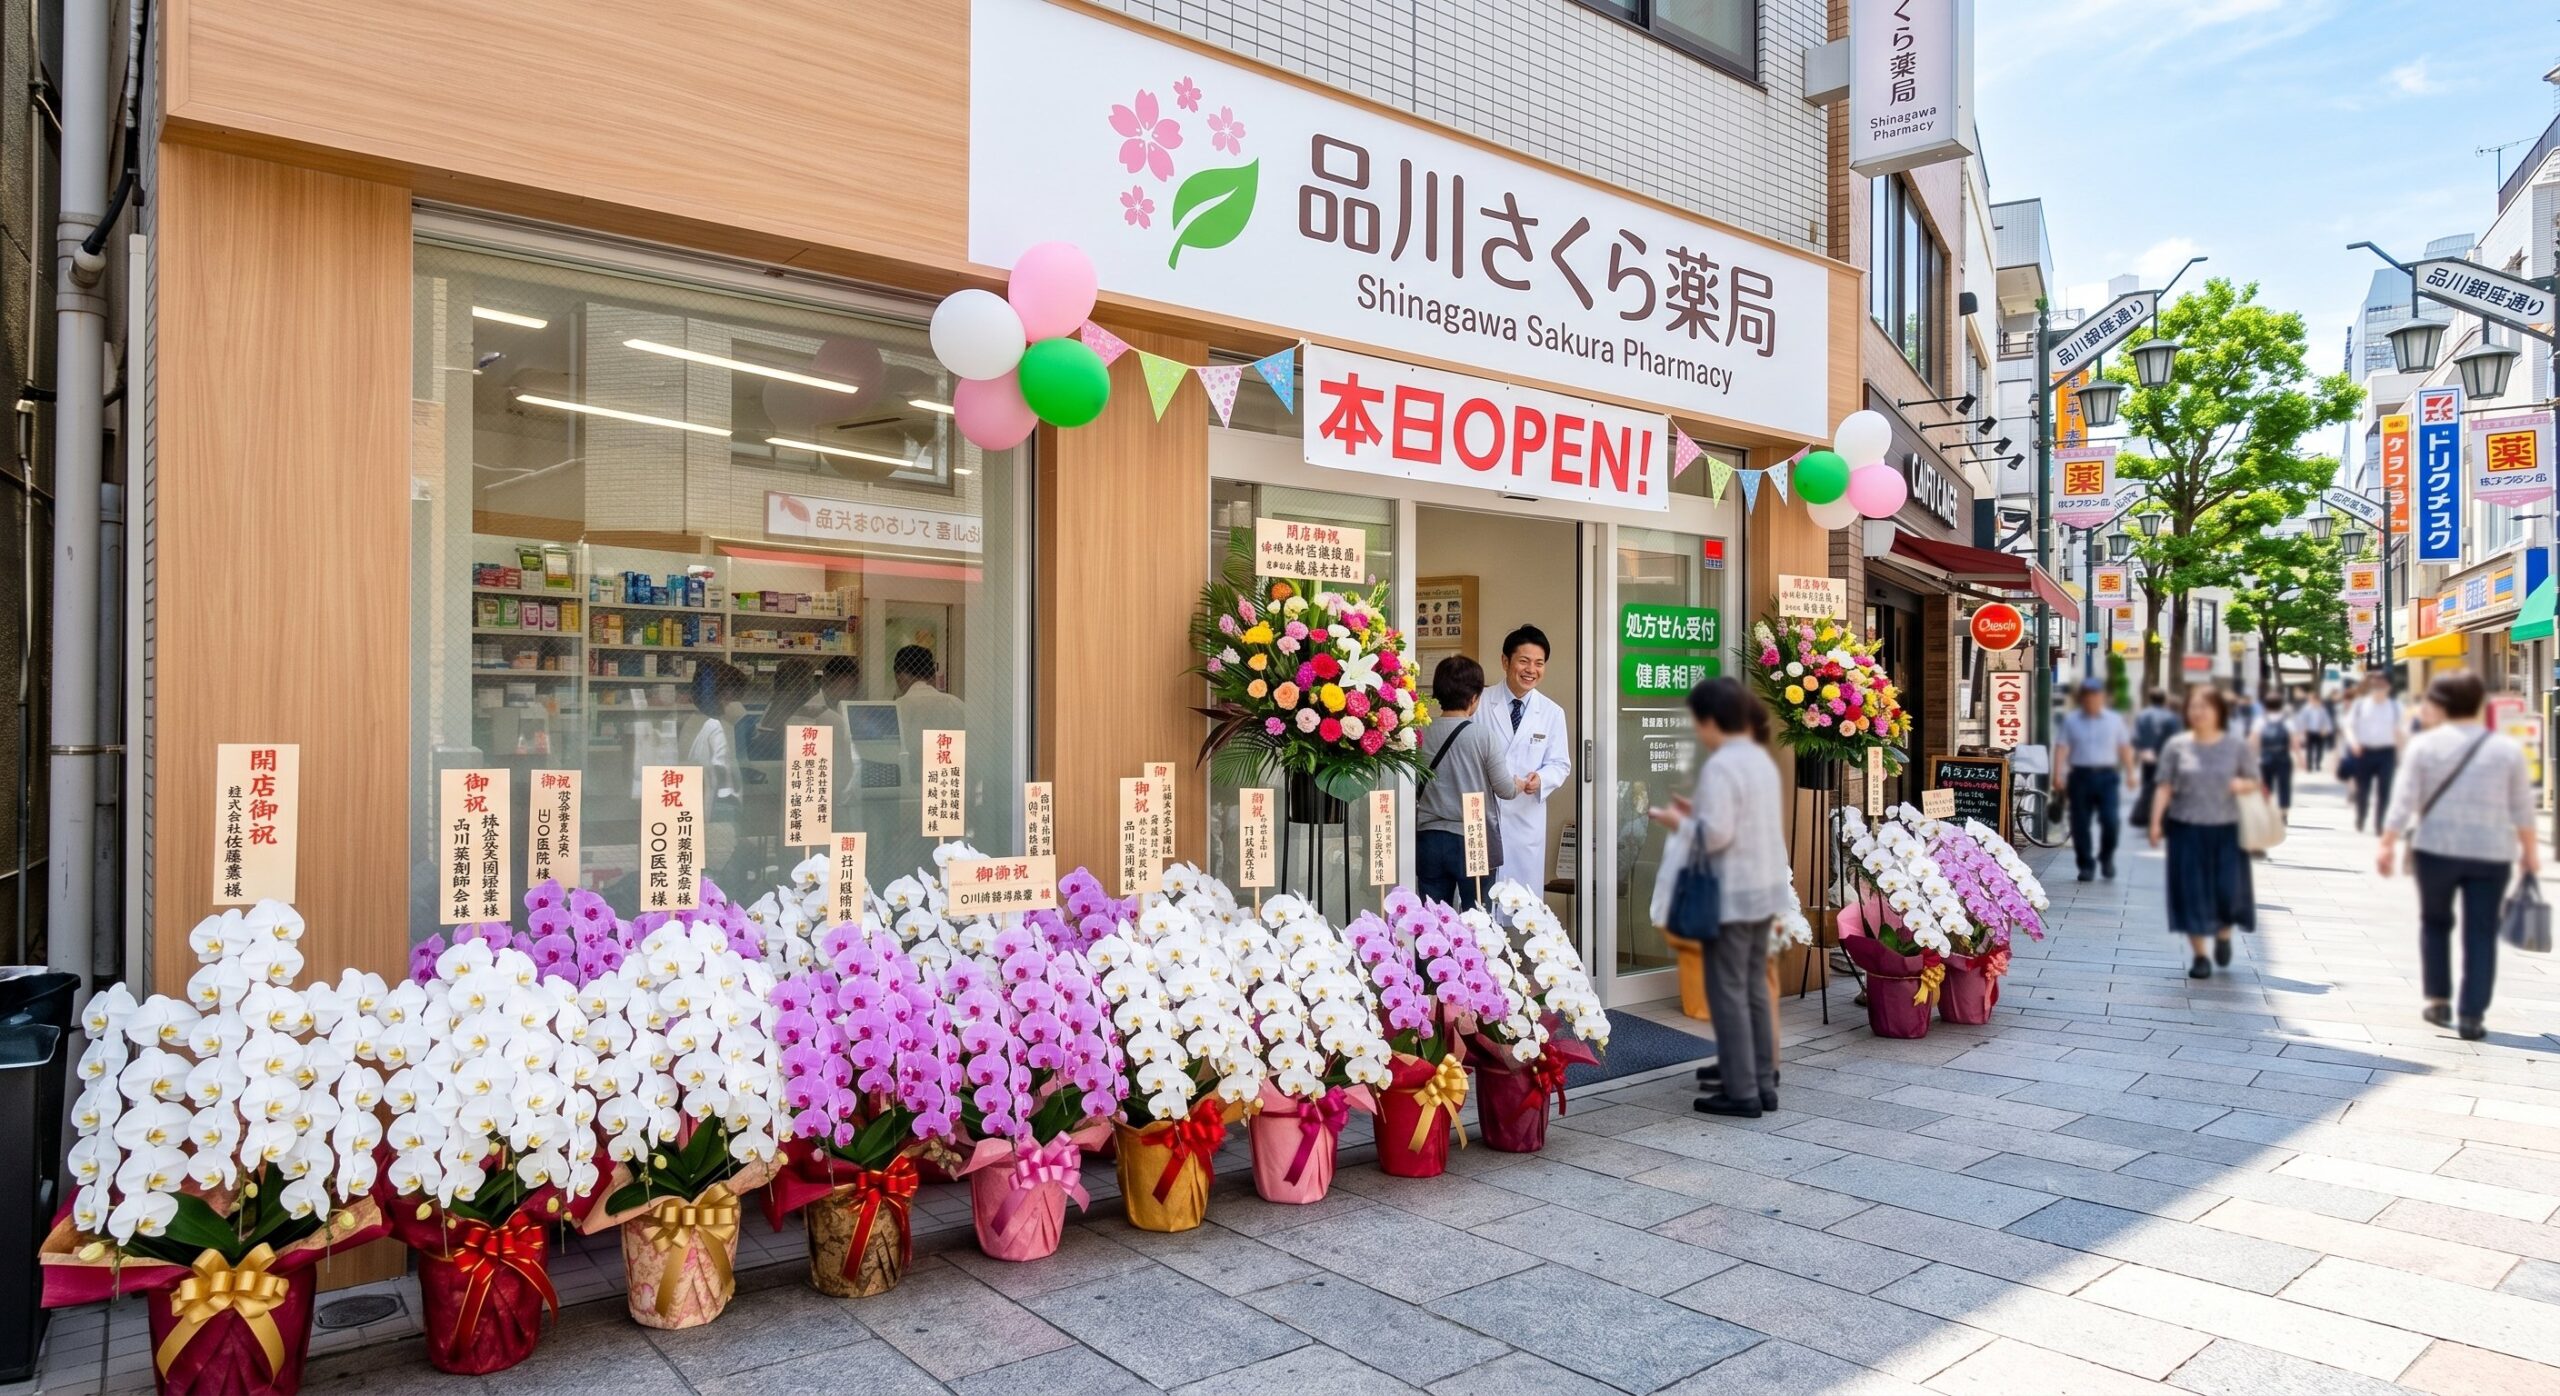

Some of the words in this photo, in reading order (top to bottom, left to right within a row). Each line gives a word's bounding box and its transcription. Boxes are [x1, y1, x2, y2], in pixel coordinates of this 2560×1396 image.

[1870, 106, 1937, 129] Shinagawa
[1873, 120, 1935, 141] Pharmacy
[1298, 133, 1776, 359] 品川さくら薬局
[2426, 267, 2545, 316] 品川銀座通り
[1357, 273, 1517, 342] Shinagawa
[1527, 315, 1614, 364] Sakura
[1624, 338, 1733, 395] Pharmacy
[1318, 372, 1653, 496] 本日OPEN!
[2491, 436, 2533, 468] 薬
[2068, 465, 2100, 493] 薬
[1626, 612, 1716, 642] 処方せん受付
[248, 749, 278, 845] 開店御祝
[464, 772, 489, 814] 御祝
[661, 769, 684, 808] 御祝
